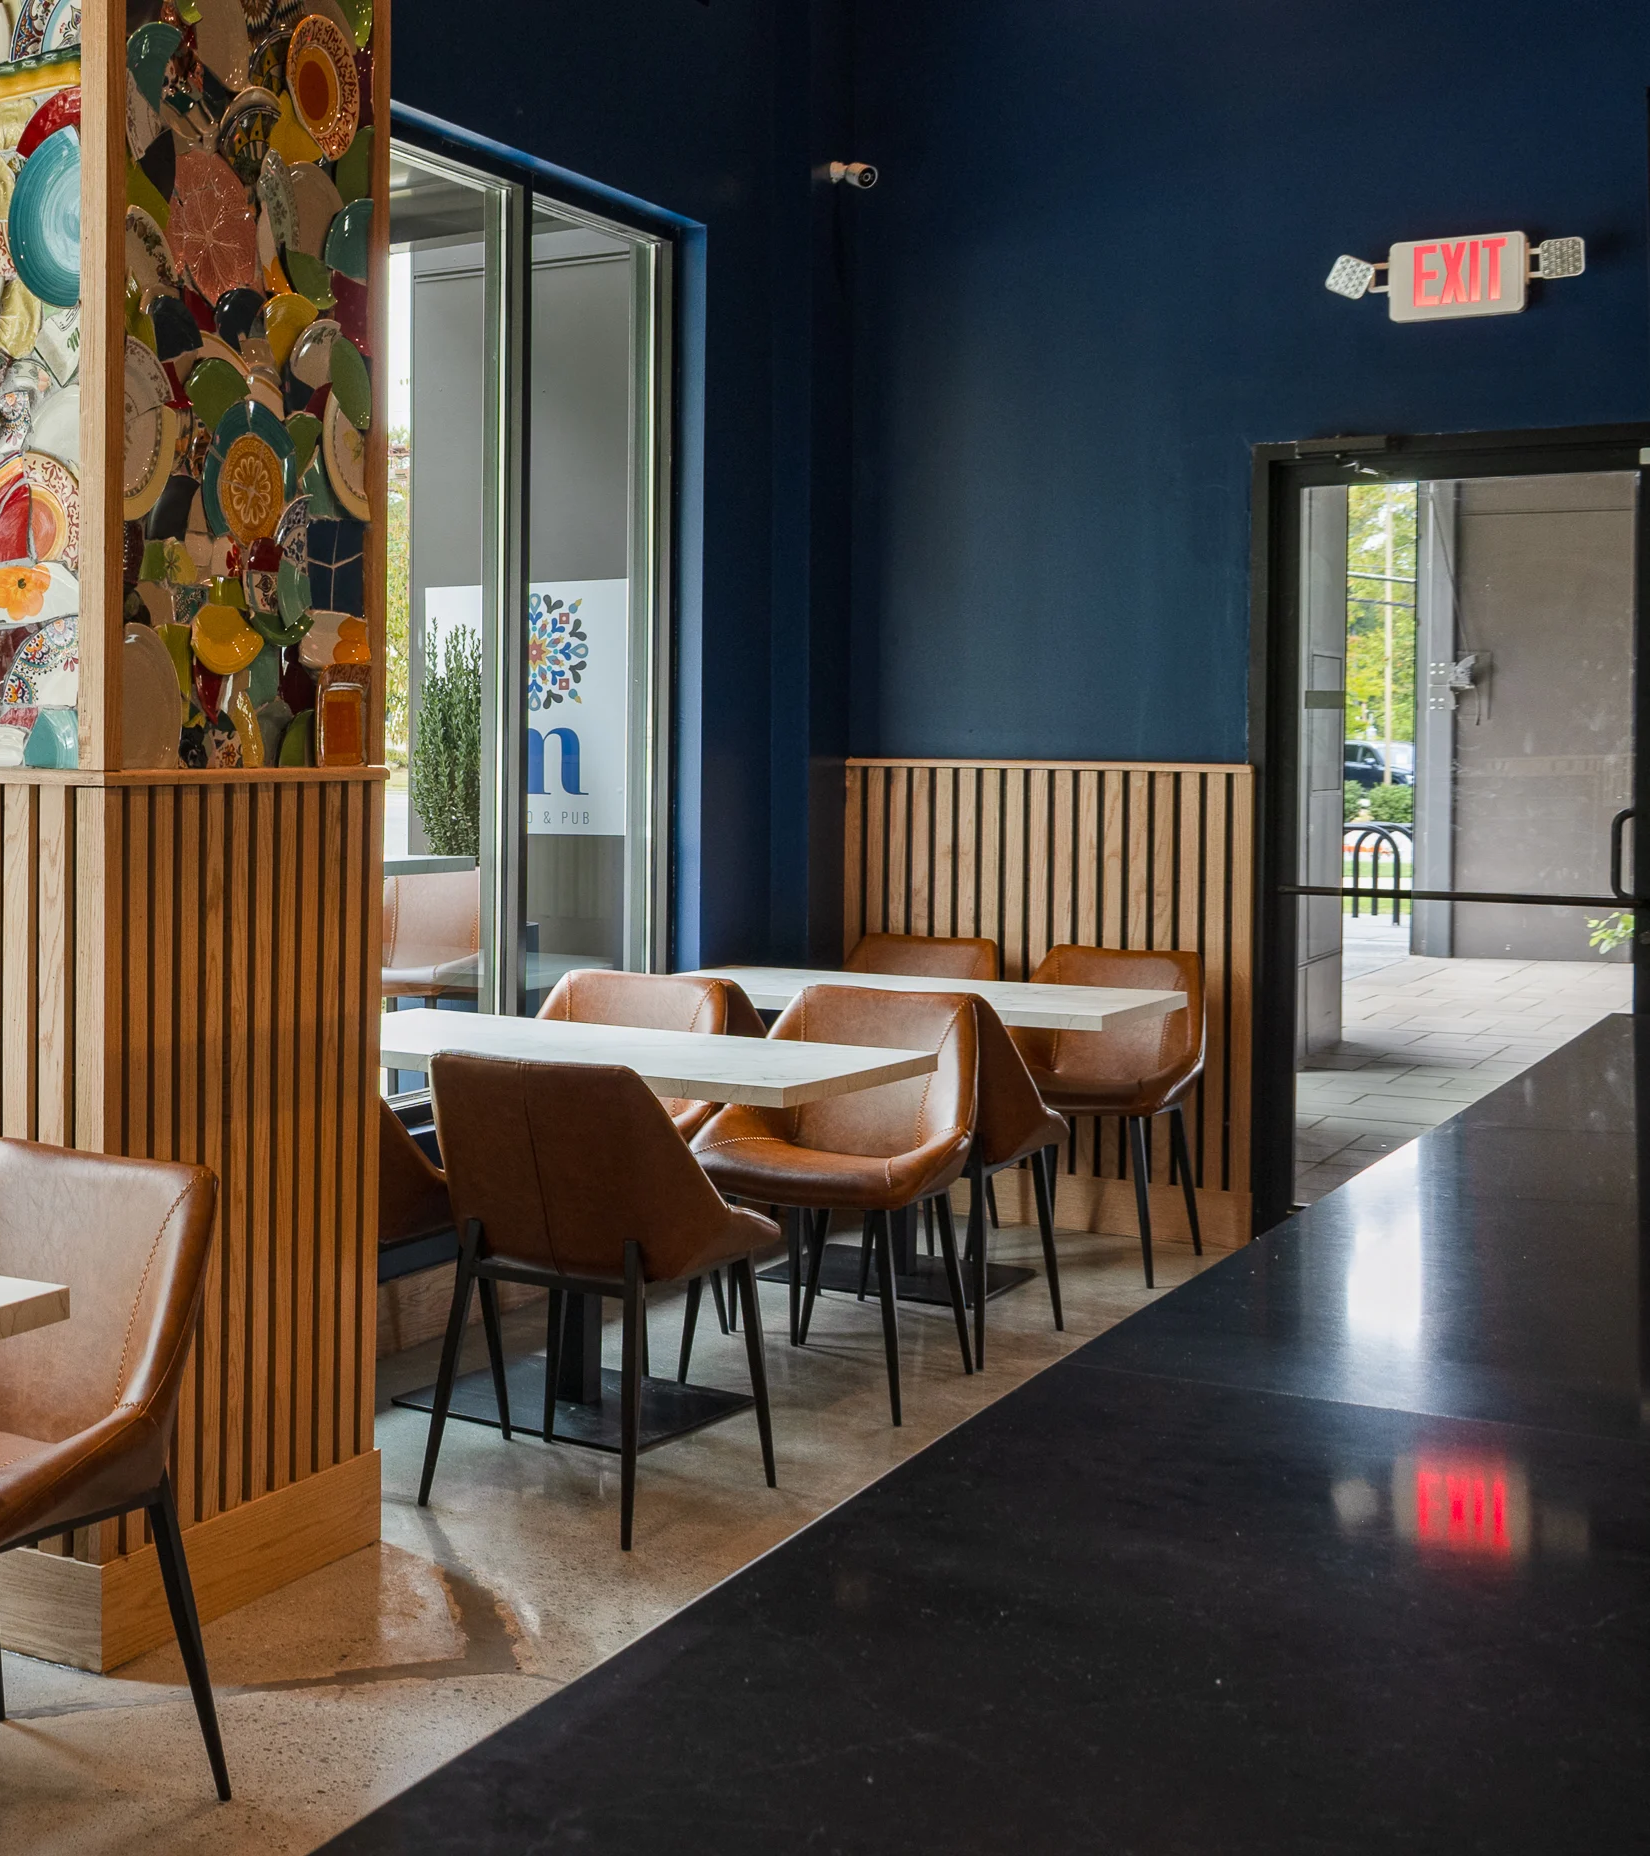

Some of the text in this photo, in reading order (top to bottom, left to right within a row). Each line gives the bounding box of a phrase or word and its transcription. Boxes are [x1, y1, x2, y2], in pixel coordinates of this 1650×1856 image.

[1413, 237, 1508, 307] EXIT
[543, 811, 552, 824] &
[562, 811, 589, 825] PUB
